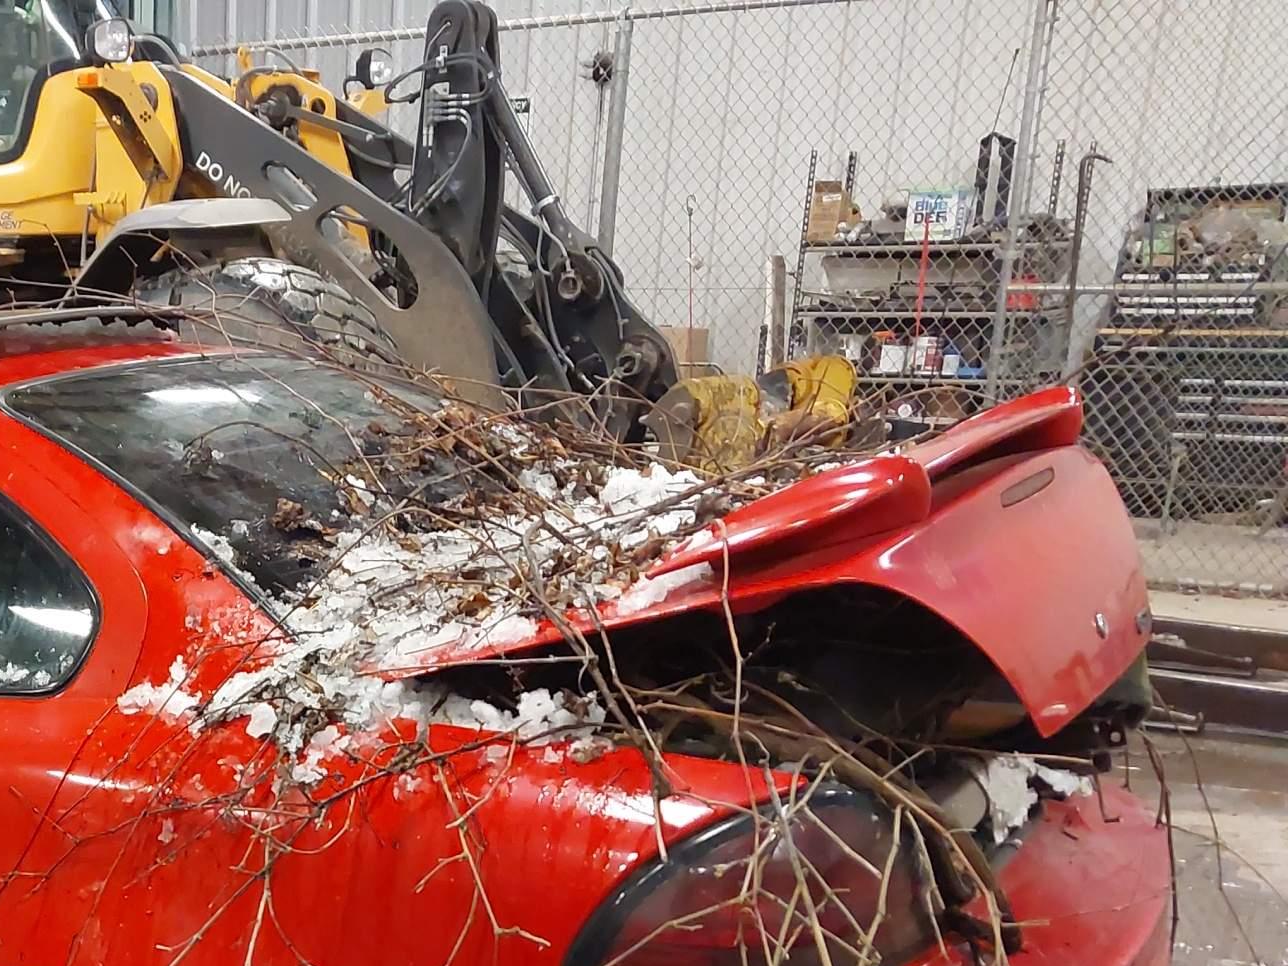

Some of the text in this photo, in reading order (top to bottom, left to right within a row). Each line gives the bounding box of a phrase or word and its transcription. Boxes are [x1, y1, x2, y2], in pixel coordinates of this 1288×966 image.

[196, 151, 253, 199] DO NO
[913, 211, 948, 224] DEF
